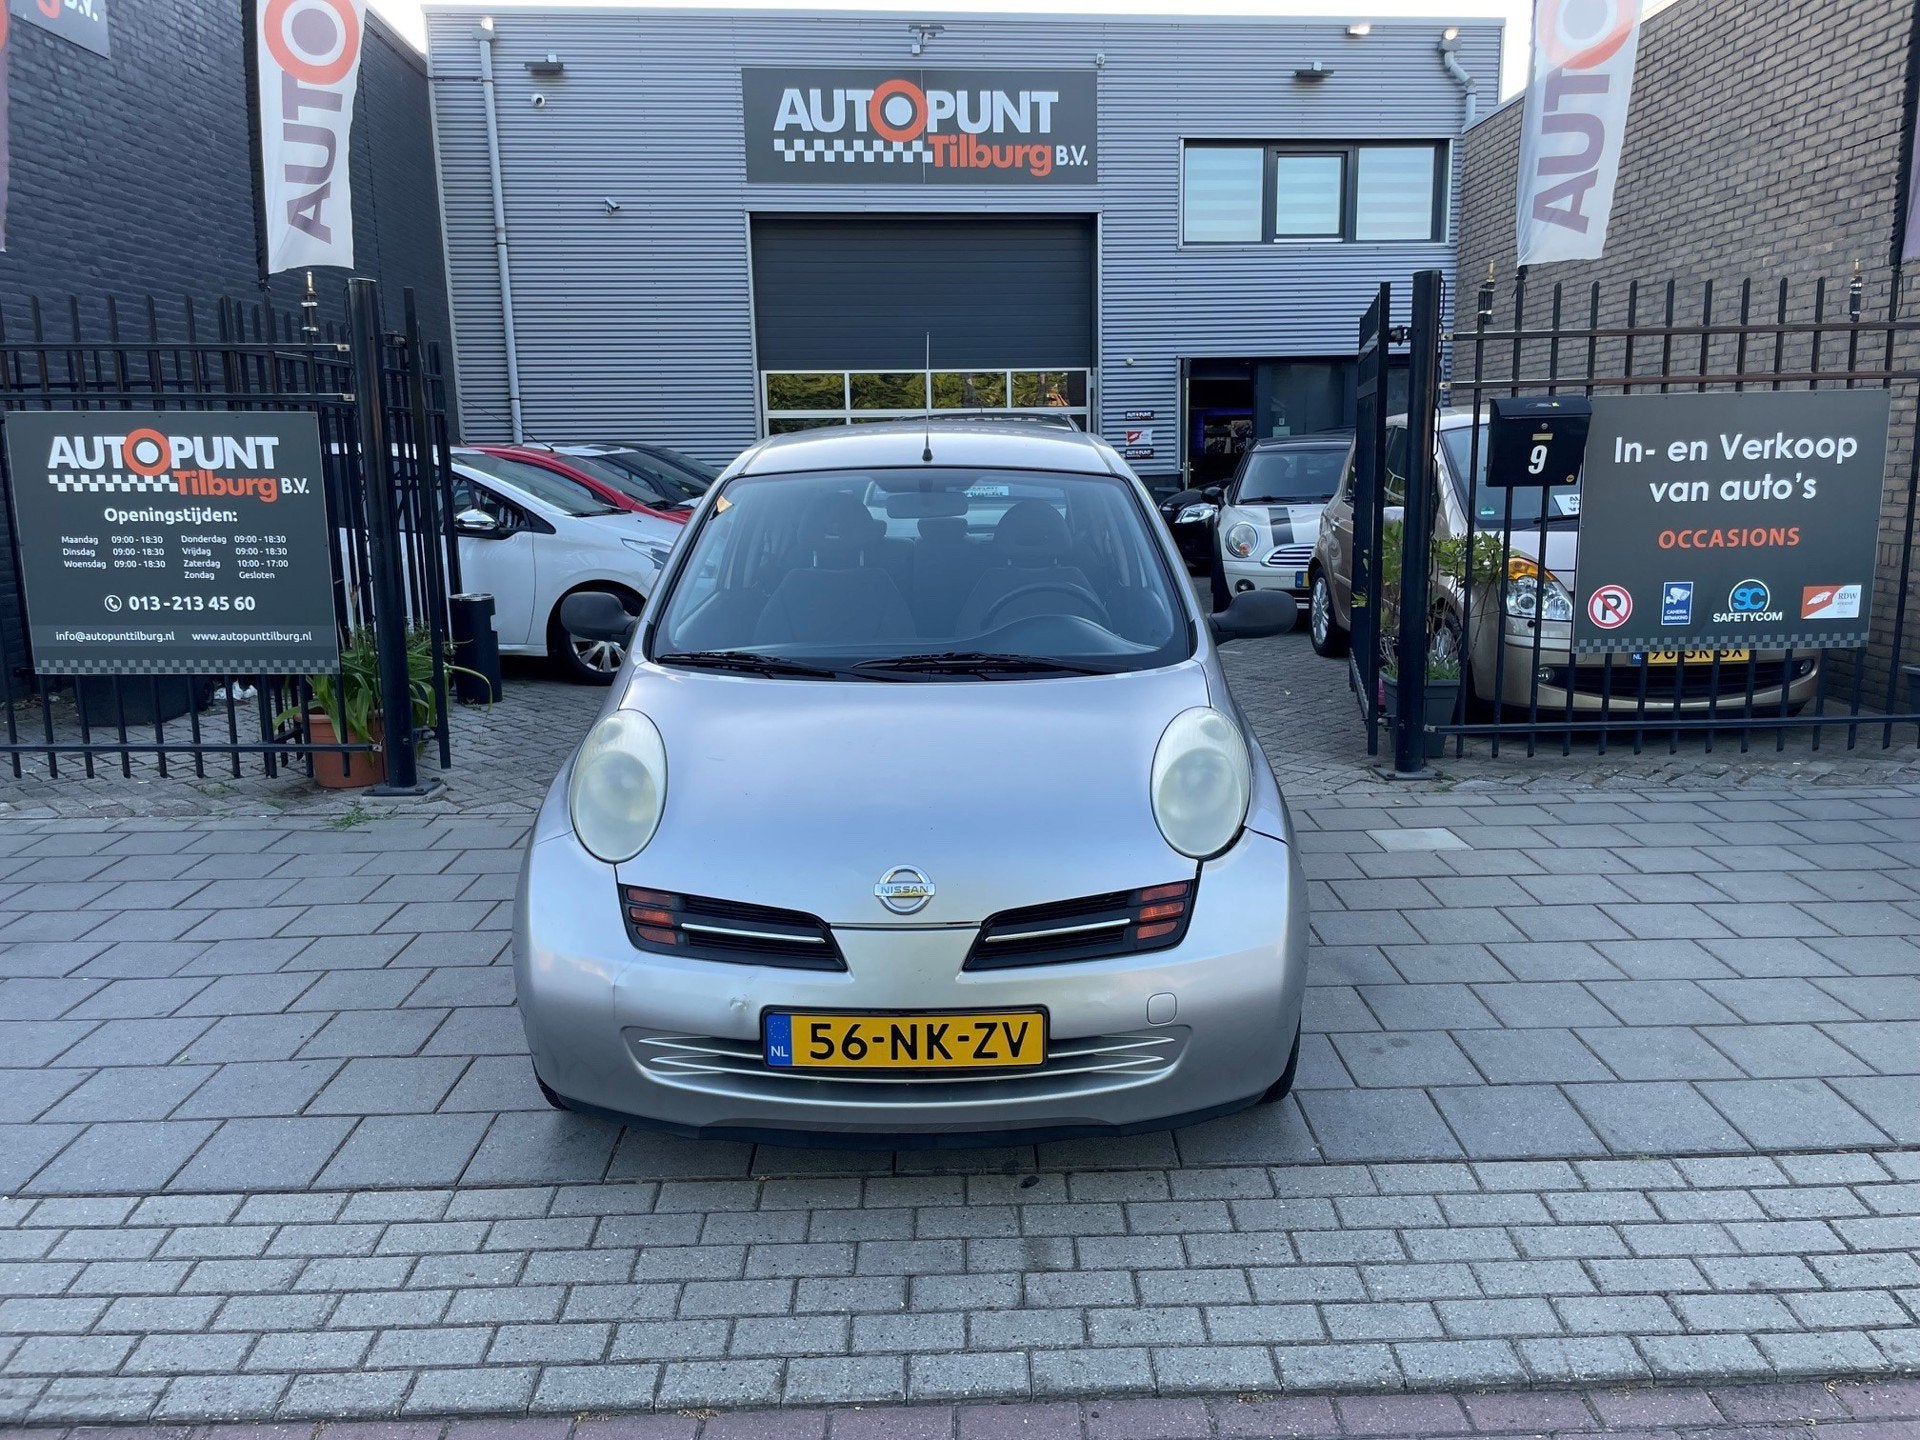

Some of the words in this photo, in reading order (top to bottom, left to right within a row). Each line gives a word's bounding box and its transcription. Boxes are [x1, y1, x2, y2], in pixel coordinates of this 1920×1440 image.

[773, 79, 1059, 143] AUTOPUNT
[928, 134, 1052, 177] Tilburg
[1055, 145, 1089, 166] B.V.
[48, 428, 279, 476] AUTOPUNT
[1614, 436, 1656, 463] In-
[1667, 440, 1708, 462] en
[1720, 432, 1858, 465] Verkoop
[1528, 445, 1548, 474] 9
[172, 470, 278, 503] Tilburg
[281, 477, 310, 494] B.V.
[1649, 480, 1710, 503] van
[104, 507, 239, 525] Openingstijden:
[61, 535, 99, 545] Maandag
[111, 535, 134, 544] 09:00
[140, 535, 164, 544] 18:30
[180, 535, 227, 544] Donderdag
[234, 535, 257, 543] 09:00
[263, 535, 287, 543] 18:30
[1658, 527, 1801, 549] OCCASIONS
[63, 548, 96, 557] Dinsdag
[112, 547, 136, 556] 09:00
[142, 547, 165, 556] 18:30
[182, 547, 212, 556] Vrijdag
[235, 547, 259, 555] 09:00
[265, 547, 288, 555] 18:30
[63, 560, 107, 570] Woensdag
[114, 560, 137, 568] 09:00
[142, 560, 166, 568] 18:30
[183, 559, 221, 569] Zaterdag
[237, 559, 260, 567] 10:00
[265, 559, 289, 567] 17:00
[184, 570, 215, 580] Zondag
[239, 570, 275, 579] Gesloten
[1838, 592, 1858, 600] RDW
[208, 596, 230, 611] 45
[234, 596, 256, 611] 60
[1712, 611, 1783, 623] SAFETYCOM
[55, 630, 175, 643] info@autopunttilburg.nl
[191, 630, 312, 643] www.autopunttilburg.nl
[881, 885, 929, 894] NISSAN
[810, 1021, 1029, 1061] 56-NK-ZV
[771, 1045, 789, 1058] NL
